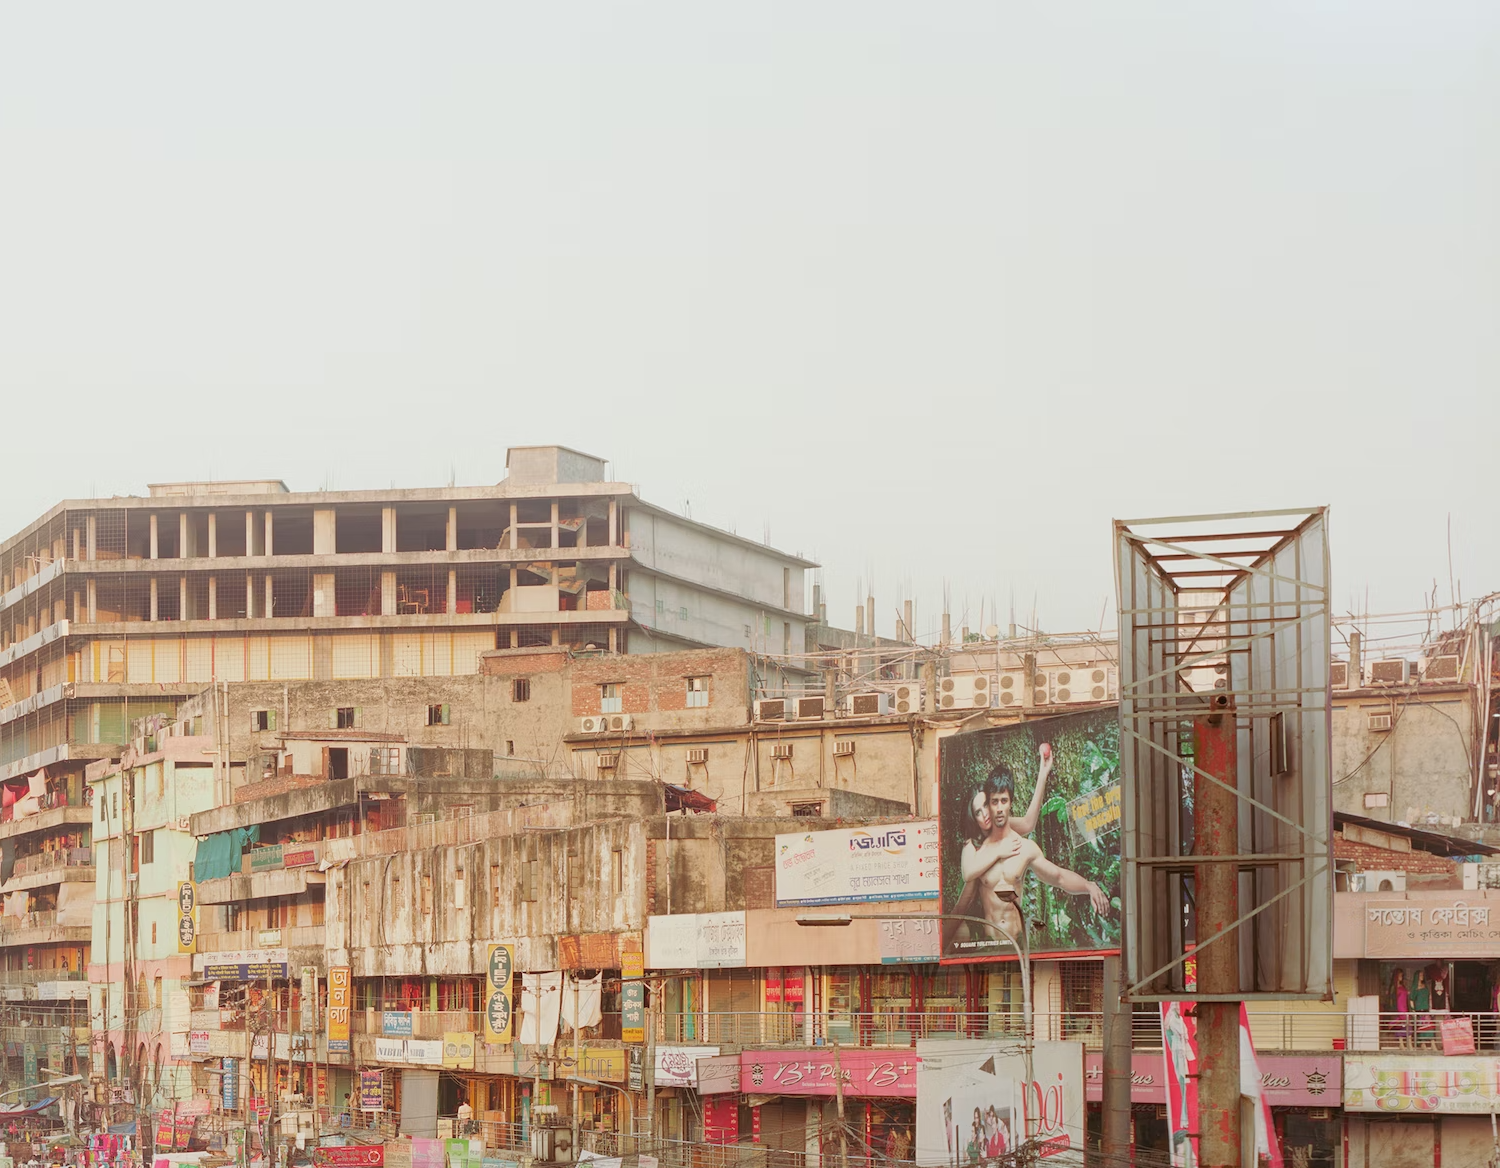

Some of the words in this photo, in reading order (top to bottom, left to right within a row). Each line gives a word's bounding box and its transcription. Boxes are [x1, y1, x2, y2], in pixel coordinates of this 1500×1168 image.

[873, 861, 891, 870] PRICE
[893, 860, 909, 869] SHOP
[1368, 906, 1424, 926] সন্তোষ
[1429, 901, 1490, 926] ফেব্রিক্স
[913, 917, 939, 936] ম্যা
